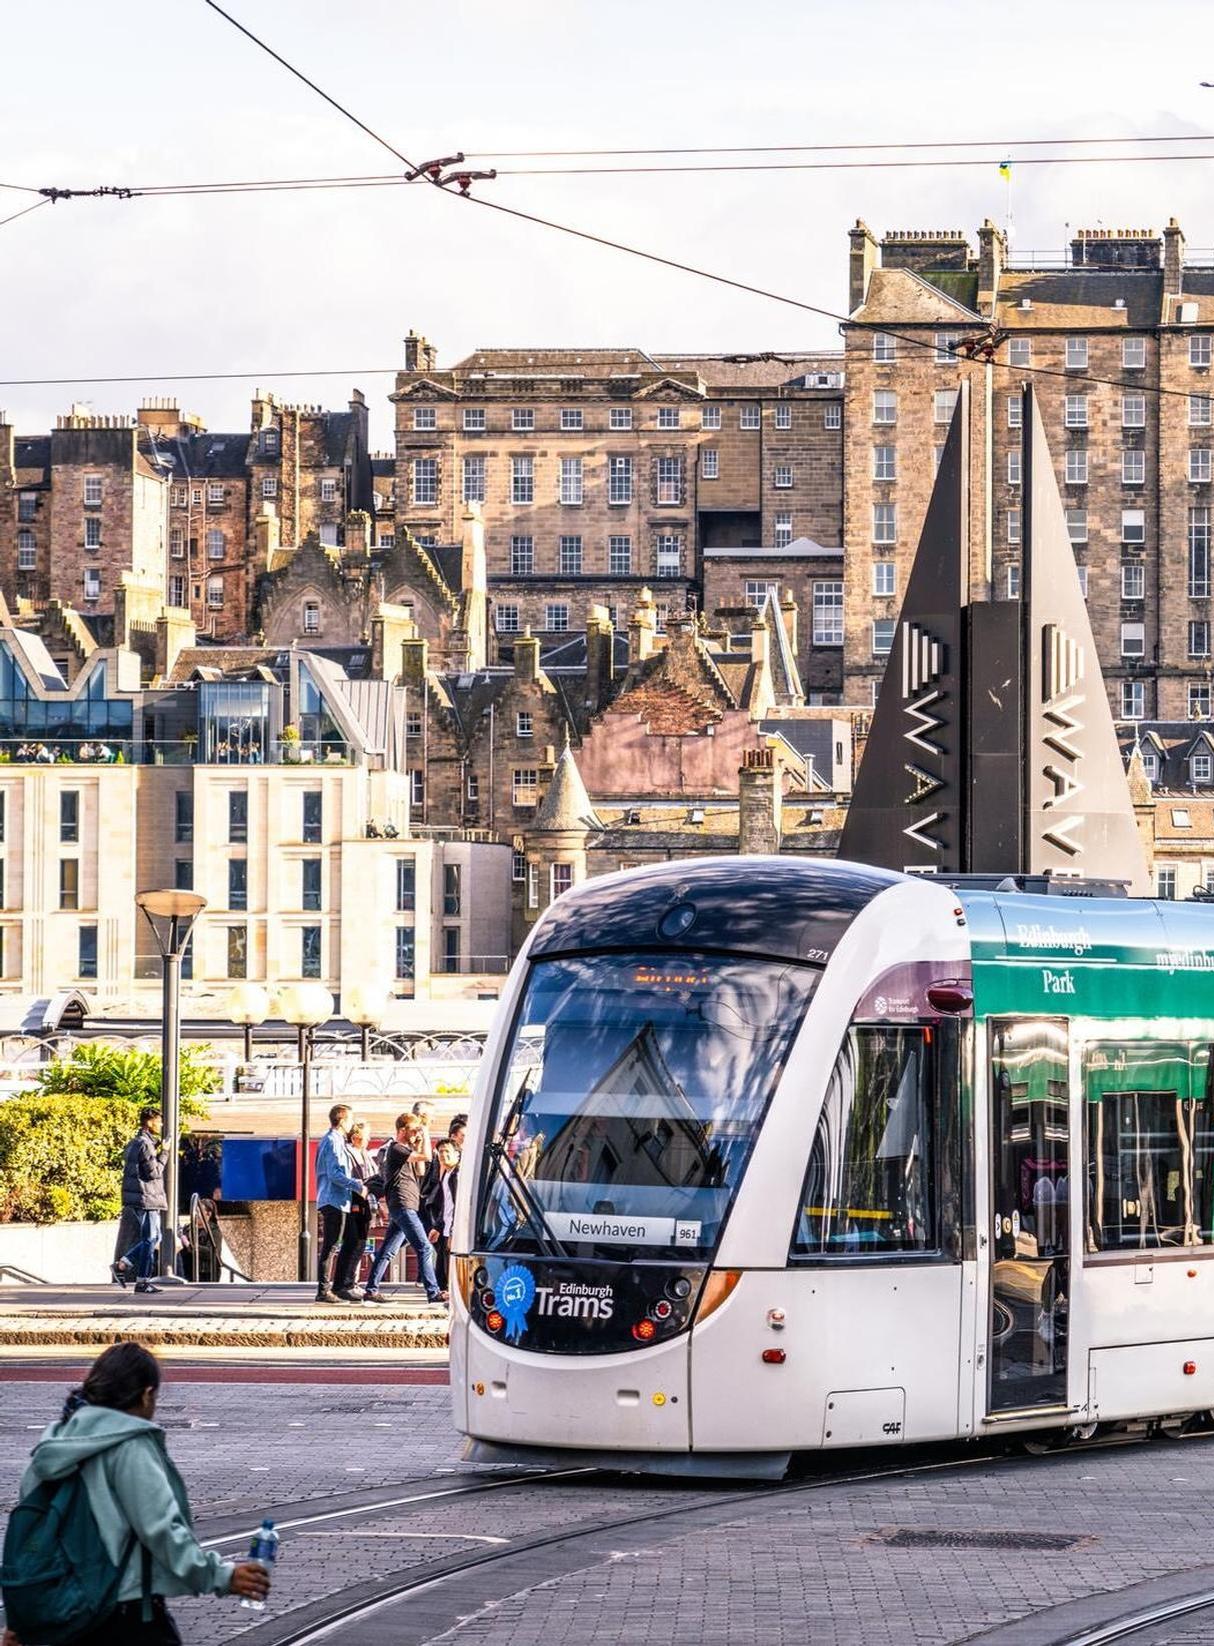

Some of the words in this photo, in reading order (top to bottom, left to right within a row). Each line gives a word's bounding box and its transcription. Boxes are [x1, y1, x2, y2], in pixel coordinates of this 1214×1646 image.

[1016, 924, 1092, 956] Edinburgh
[807, 949, 829, 961] 271
[1042, 969, 1076, 994] Park
[569, 1219, 646, 1238] Newhaven
[680, 1229, 697, 1239] 961
[560, 1283, 613, 1298] Edinburgh
[535, 1287, 614, 1319] Trams
